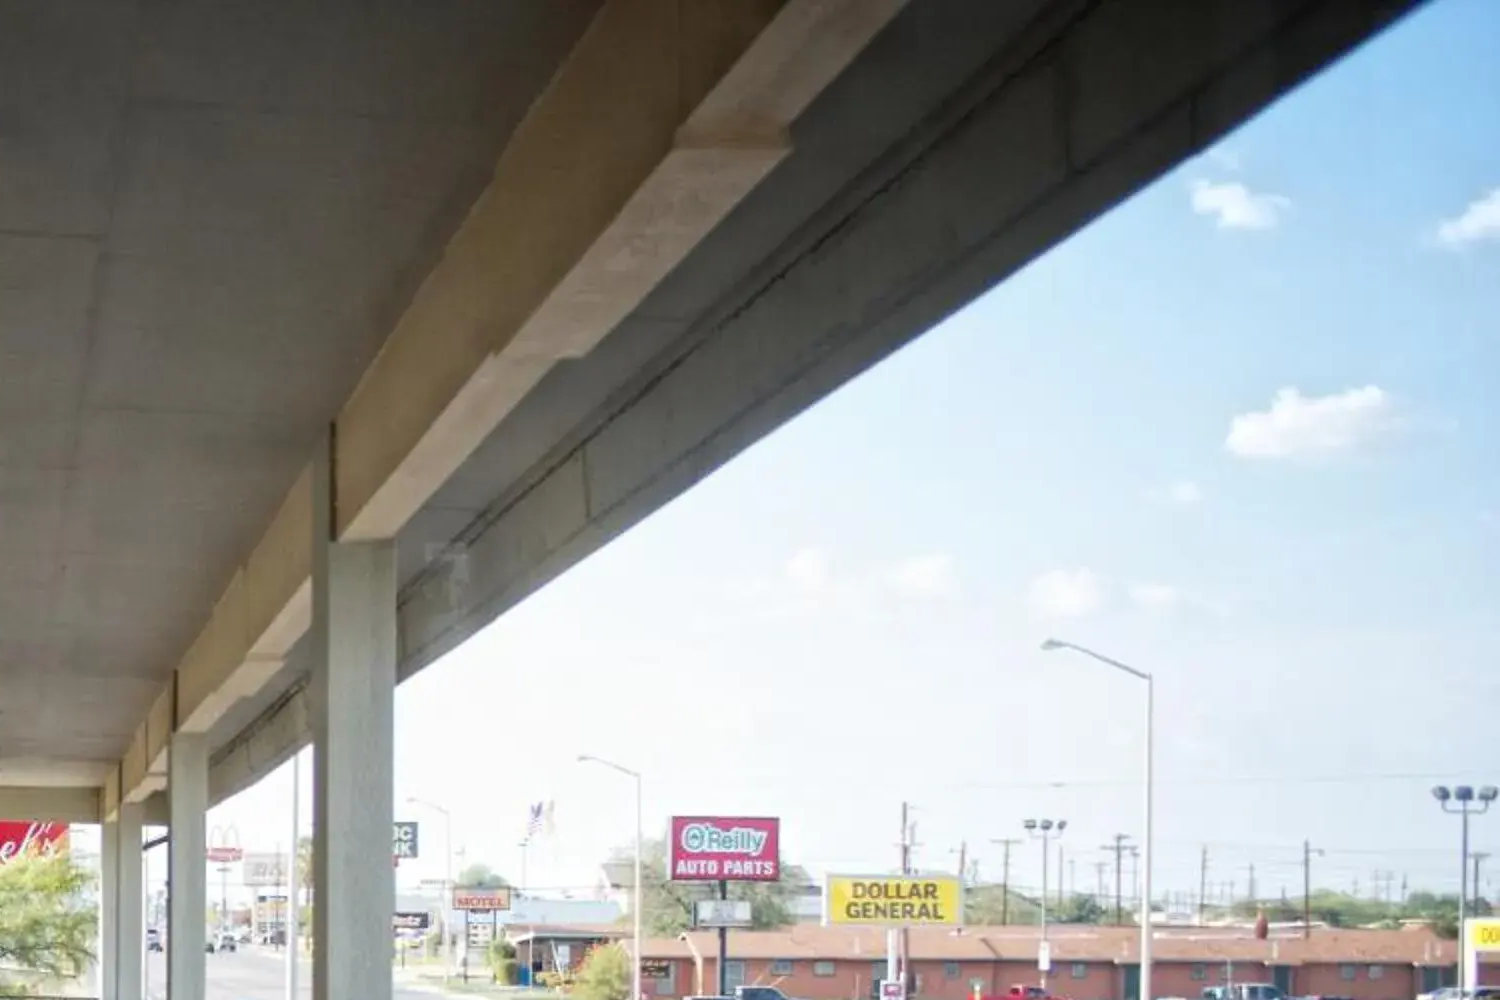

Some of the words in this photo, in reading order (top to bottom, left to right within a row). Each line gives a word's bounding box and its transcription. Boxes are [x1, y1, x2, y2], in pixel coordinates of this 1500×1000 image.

[683, 825, 766, 855] O'Reilly
[676, 860, 718, 875] AUTO
[724, 860, 774, 875] PARTS
[852, 882, 938, 899] DOLLAR
[457, 897, 503, 907] MOTEL
[846, 902, 944, 919] GENERAL
